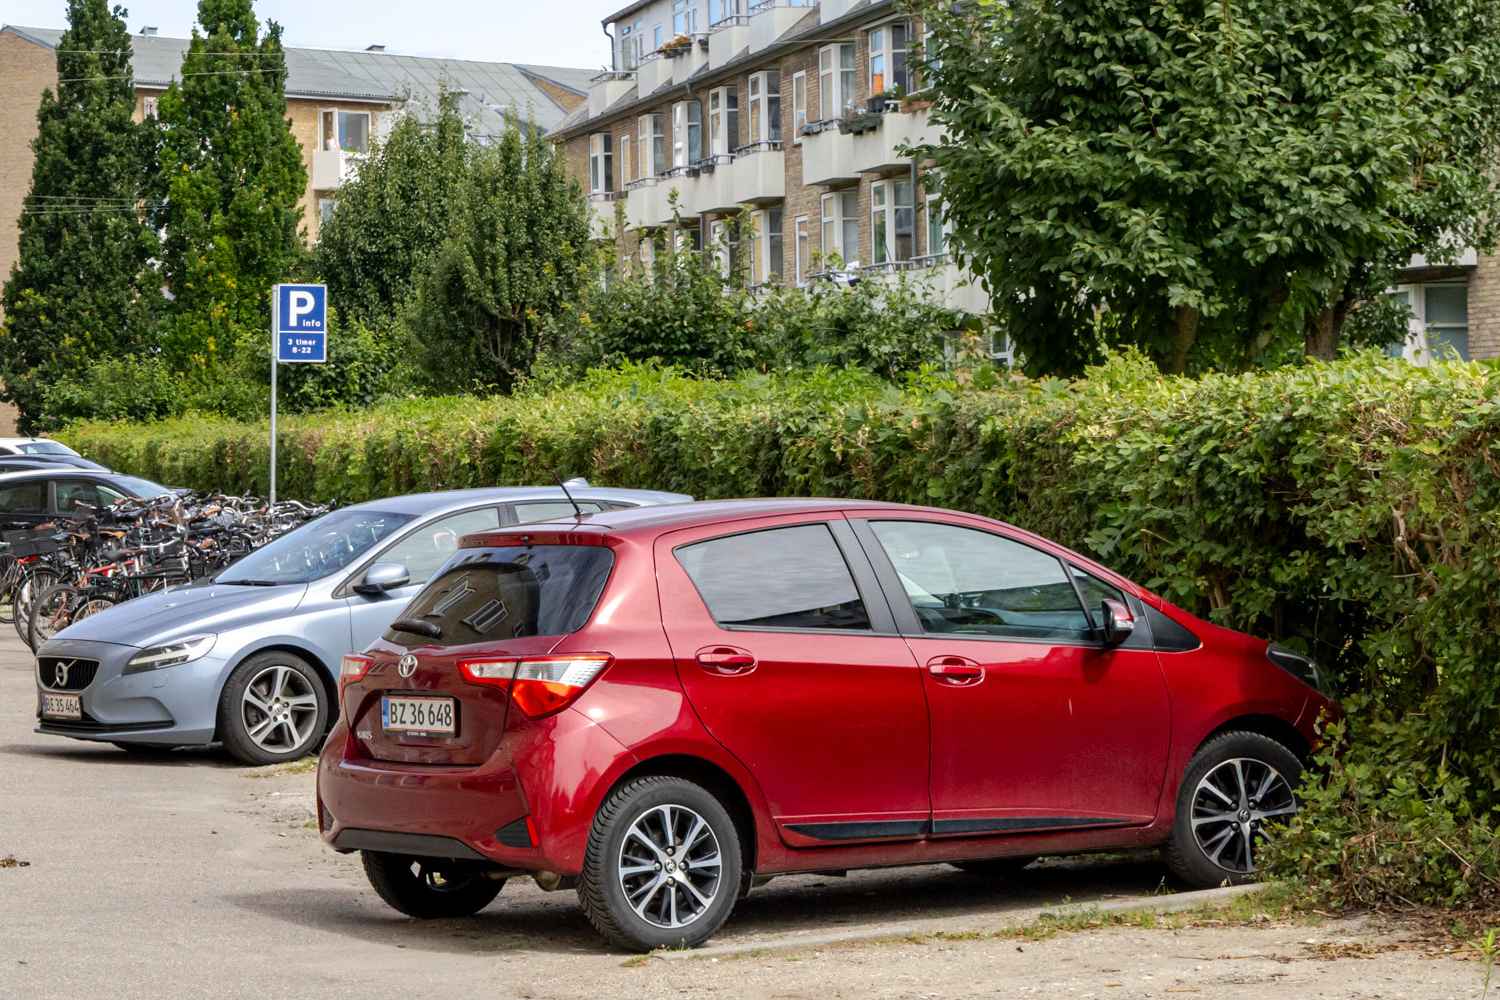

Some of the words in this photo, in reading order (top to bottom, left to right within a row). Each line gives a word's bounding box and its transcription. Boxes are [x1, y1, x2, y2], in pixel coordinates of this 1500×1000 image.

[289, 291, 315, 327] P
[56, 698, 64, 713] 35
[66, 699, 79, 713] 464
[391, 703, 406, 724] BZ
[410, 703, 424, 725] 36
[428, 703, 452, 726] 648
